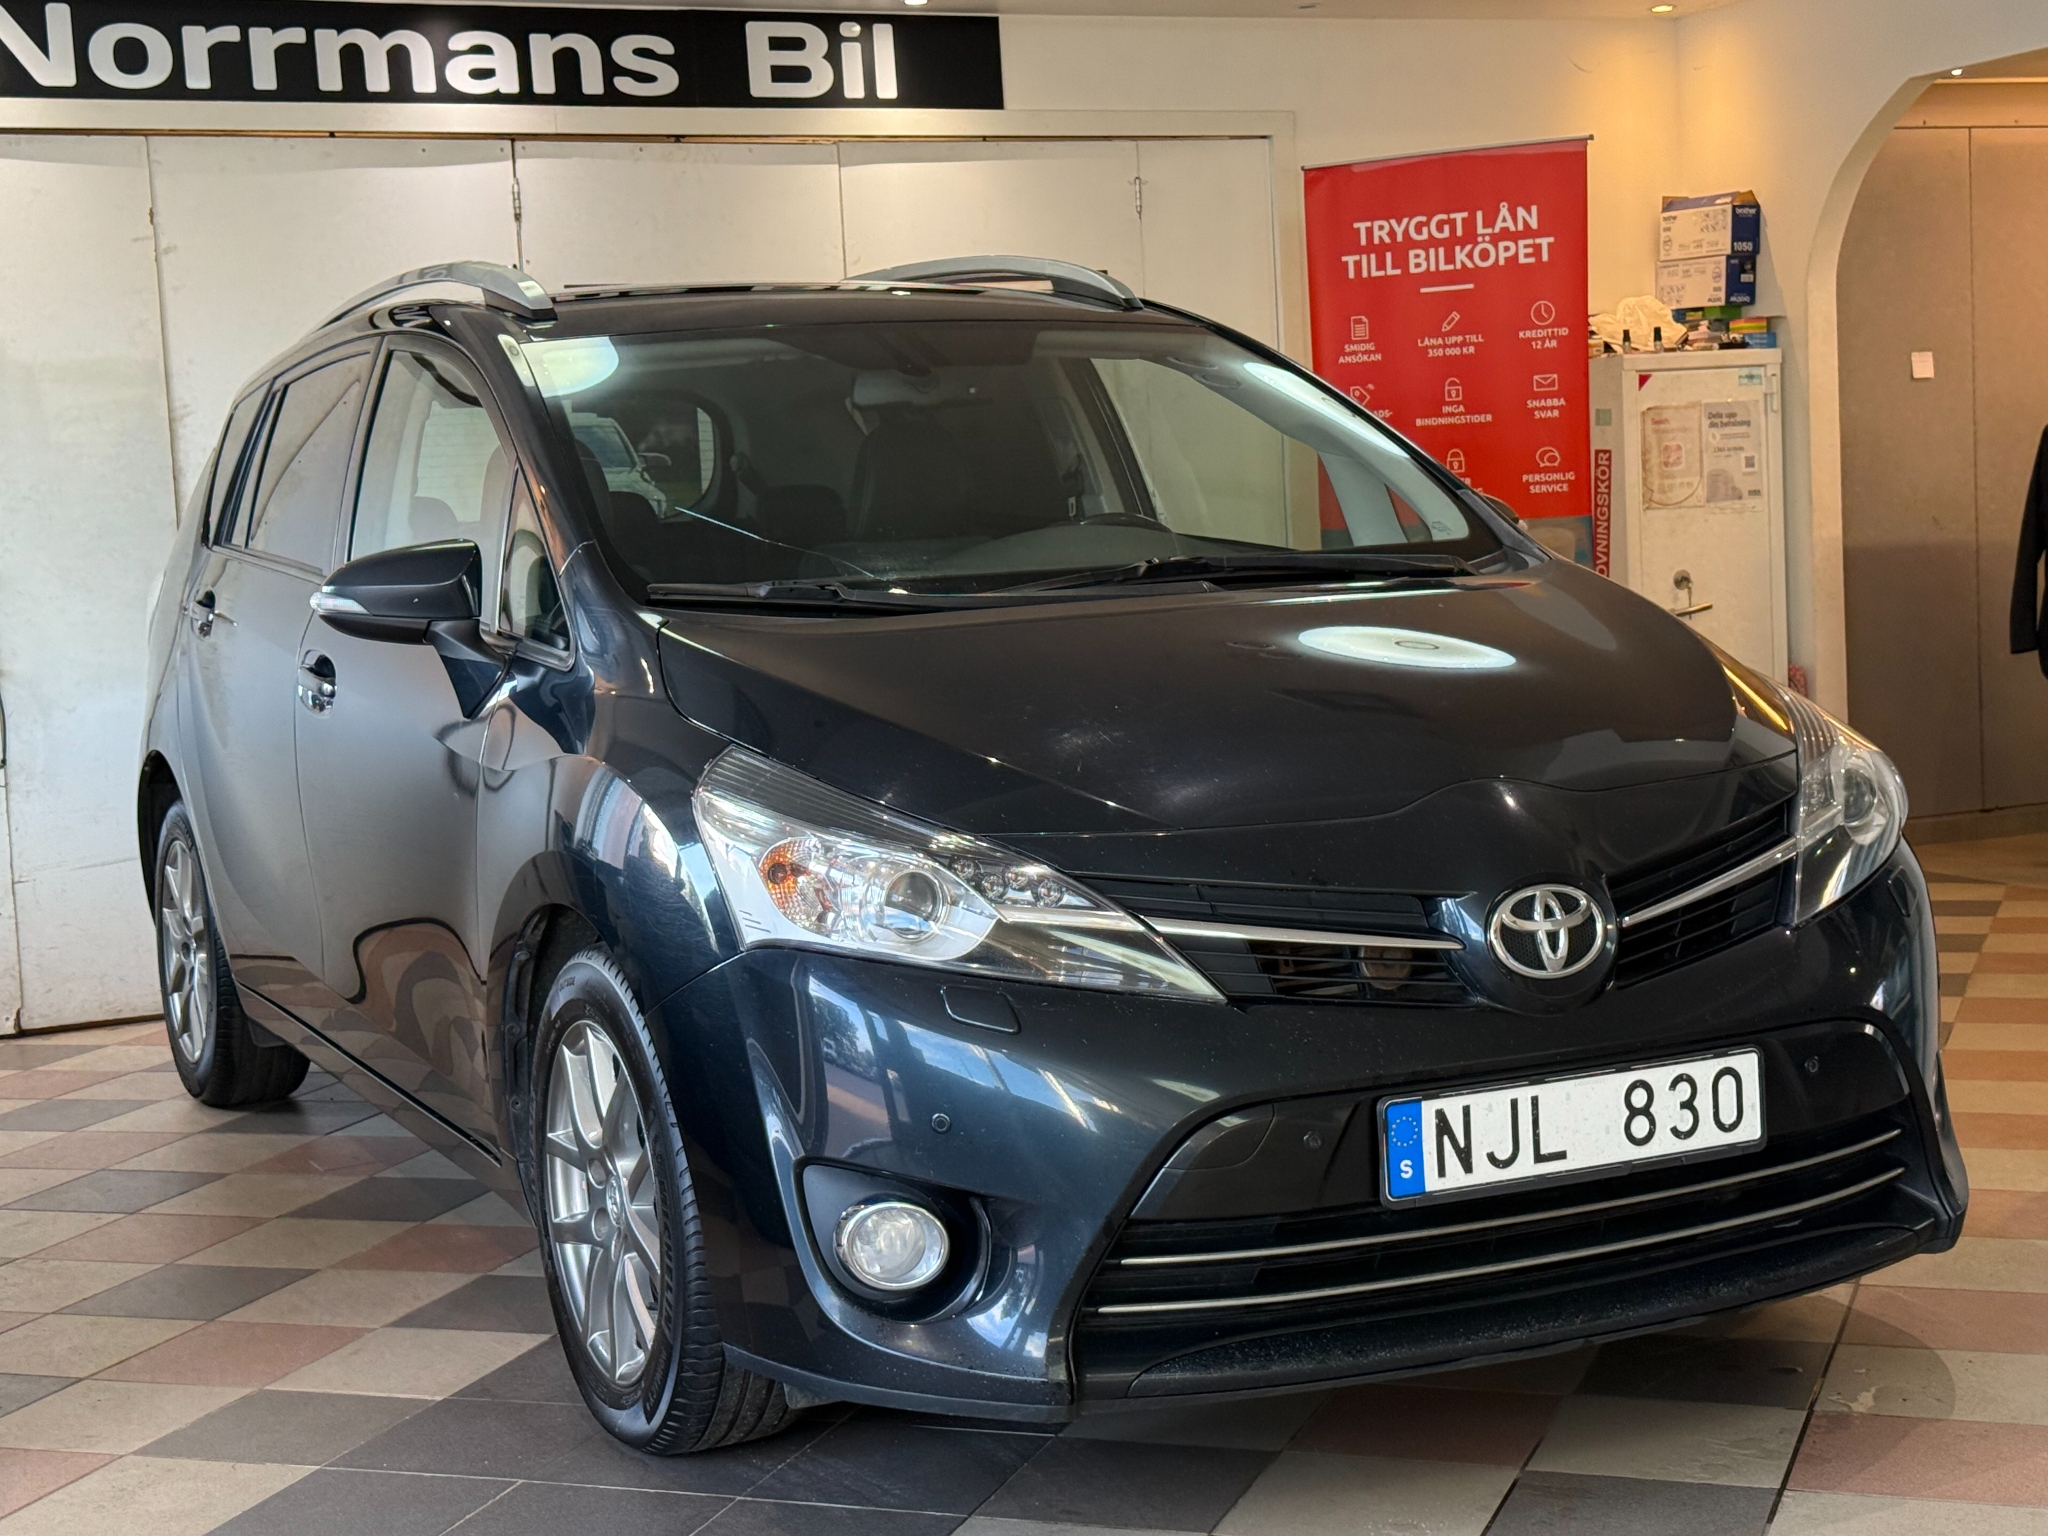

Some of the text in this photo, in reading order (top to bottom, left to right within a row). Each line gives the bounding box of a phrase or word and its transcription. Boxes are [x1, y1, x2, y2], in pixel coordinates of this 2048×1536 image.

[744, 21, 899, 100] Bil
[1353, 201, 1538, 246] TRYGGT LÅN
[1733, 241, 1753, 252] 1050
[1341, 235, 1554, 279] TILL BILKÖPET
[1519, 327, 1569, 339] KREDITTID
[1417, 334, 1484, 347] LÅNA UPP TILL
[1531, 338, 1557, 349] 12 ÅR
[1344, 343, 1376, 353] SMIDIG
[1427, 346, 1475, 357] 350 000 KR
[1338, 353, 1382, 364] ANSÖKAN
[1442, 404, 1465, 414] INGA
[1526, 397, 1566, 409] SNABBA
[1534, 409, 1559, 419] SVAR
[1415, 414, 1492, 427] BINDNINGSTIDER
[1522, 471, 1575, 483] PERSONLIG
[1529, 482, 1569, 493] SERVICE
[1434, 1066, 1744, 1178] NJL 830
[1399, 1160, 1413, 1179] S
